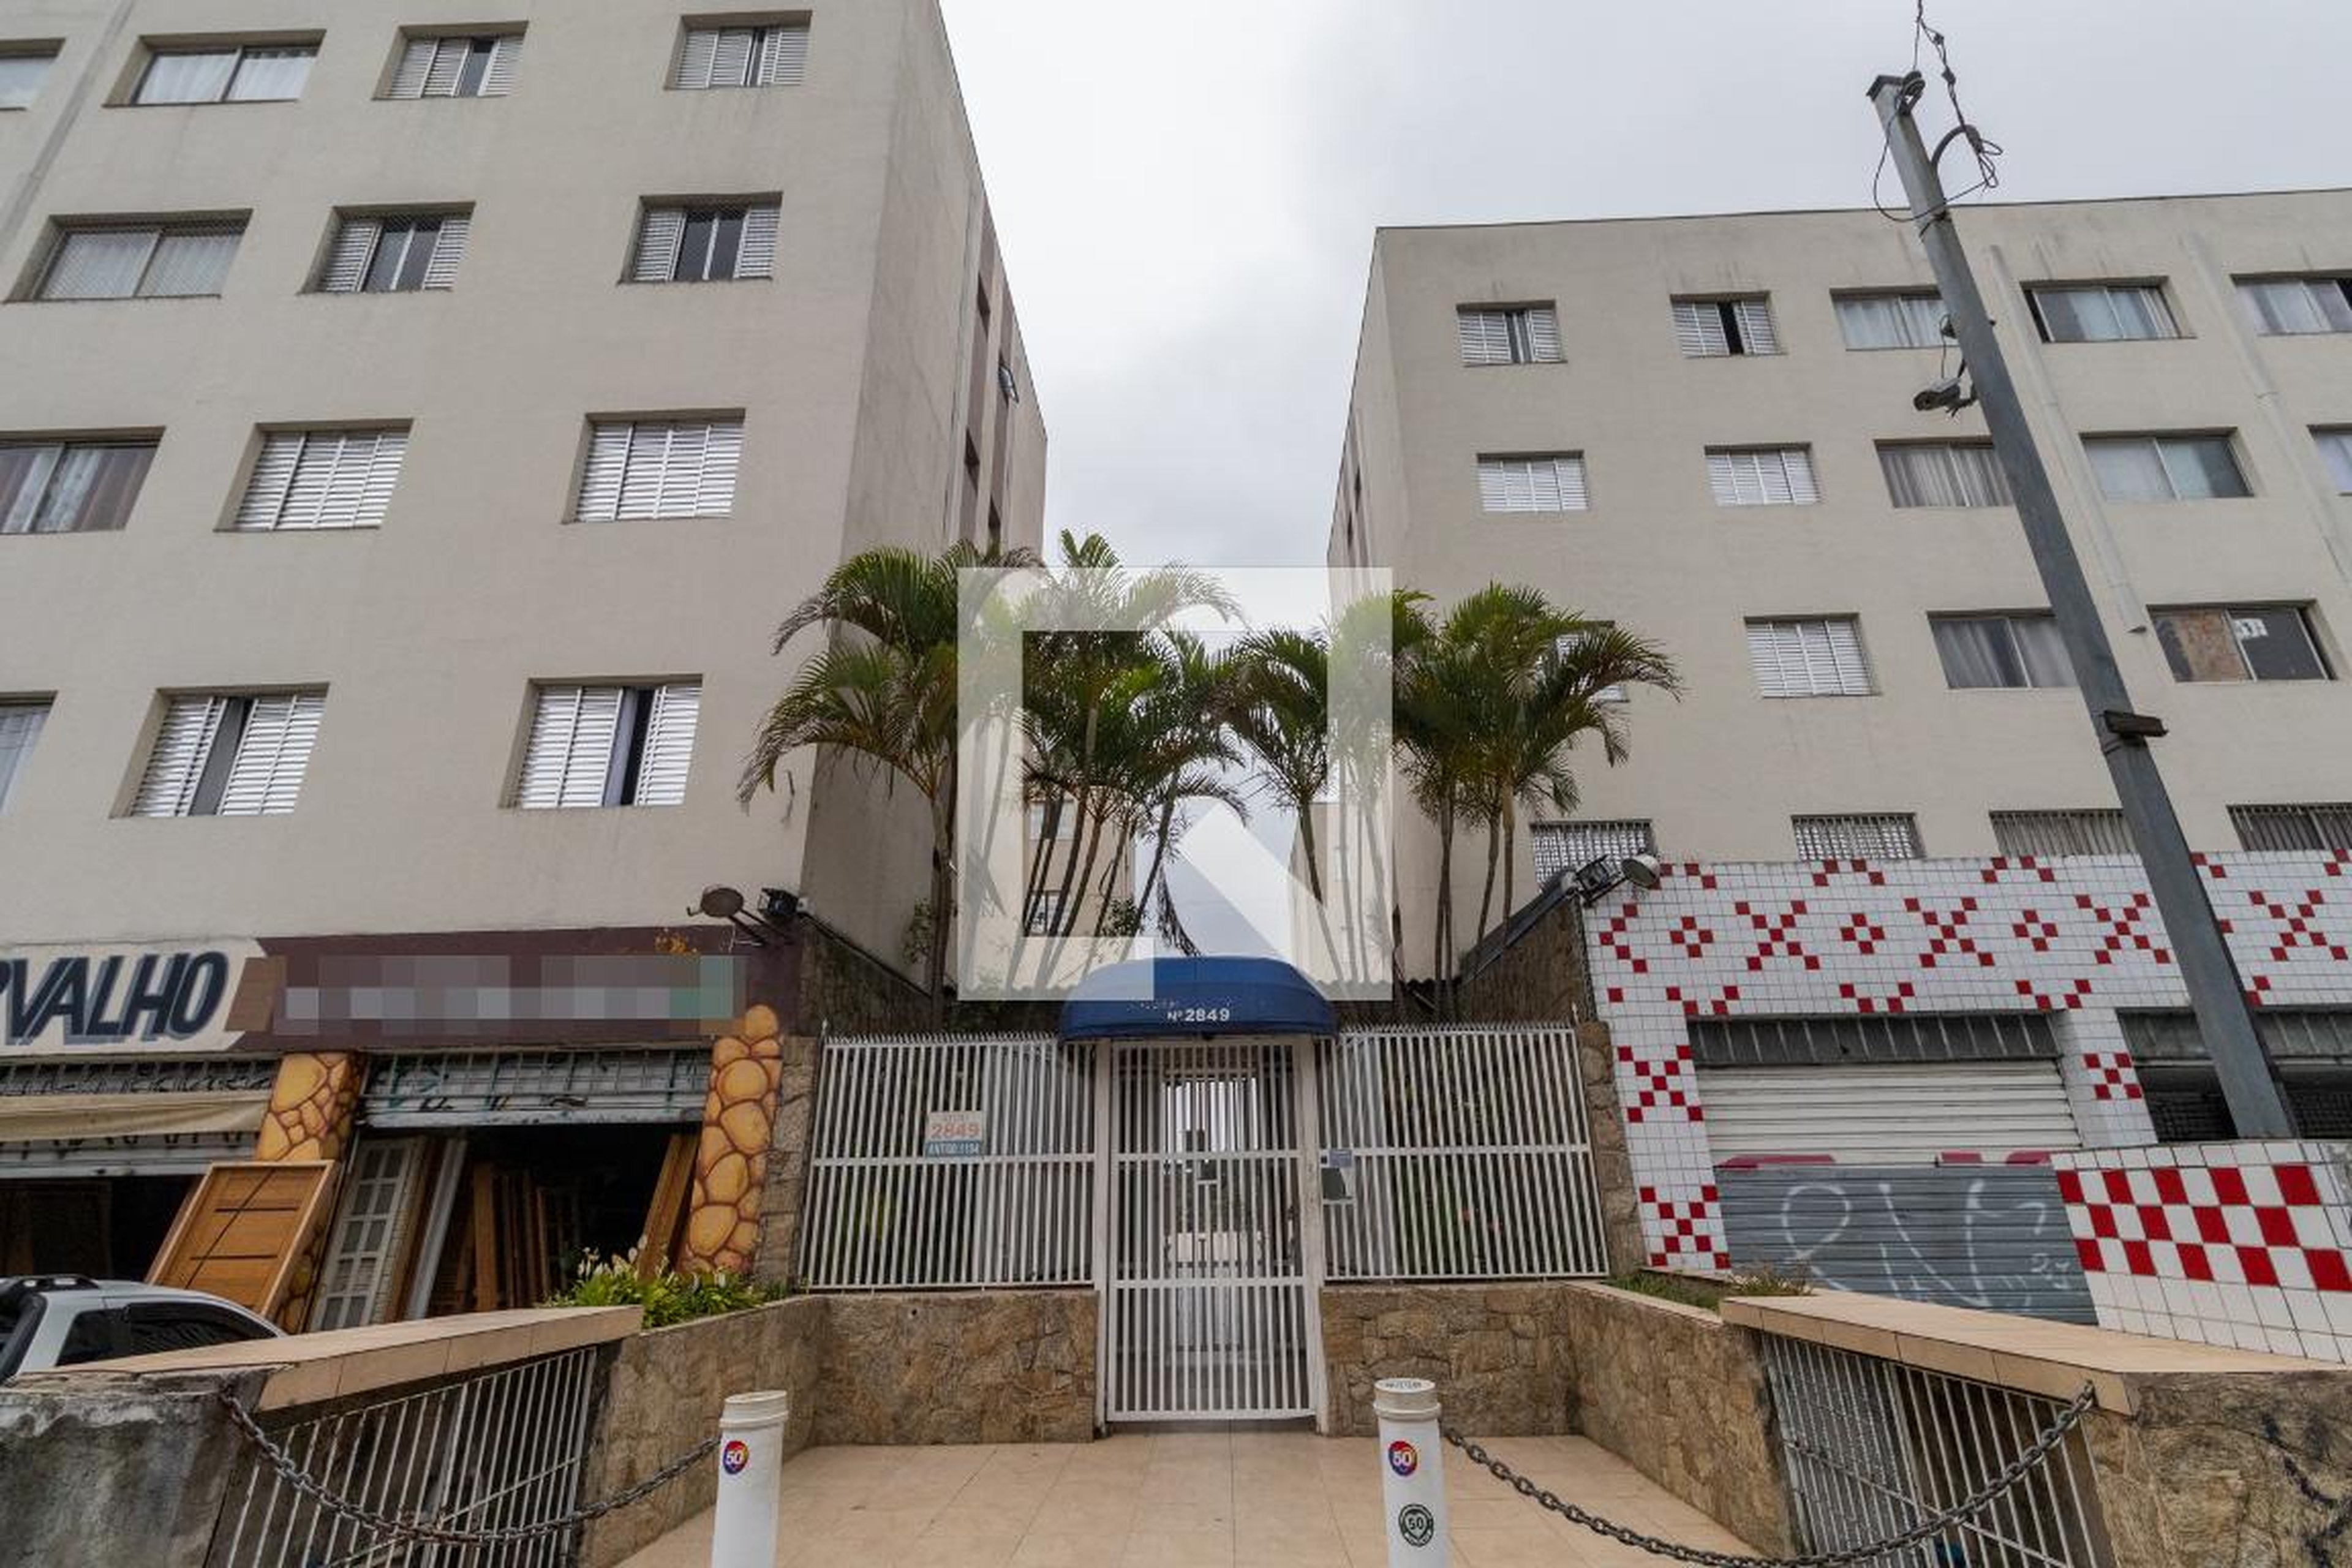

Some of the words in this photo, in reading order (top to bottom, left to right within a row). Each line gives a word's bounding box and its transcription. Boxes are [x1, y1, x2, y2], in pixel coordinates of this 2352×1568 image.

[0, 951, 228, 1046] VALHO
[1185, 1008, 1230, 1022] 2849
[931, 1123, 981, 1138] 2849
[1408, 1517, 1423, 1530] 50
